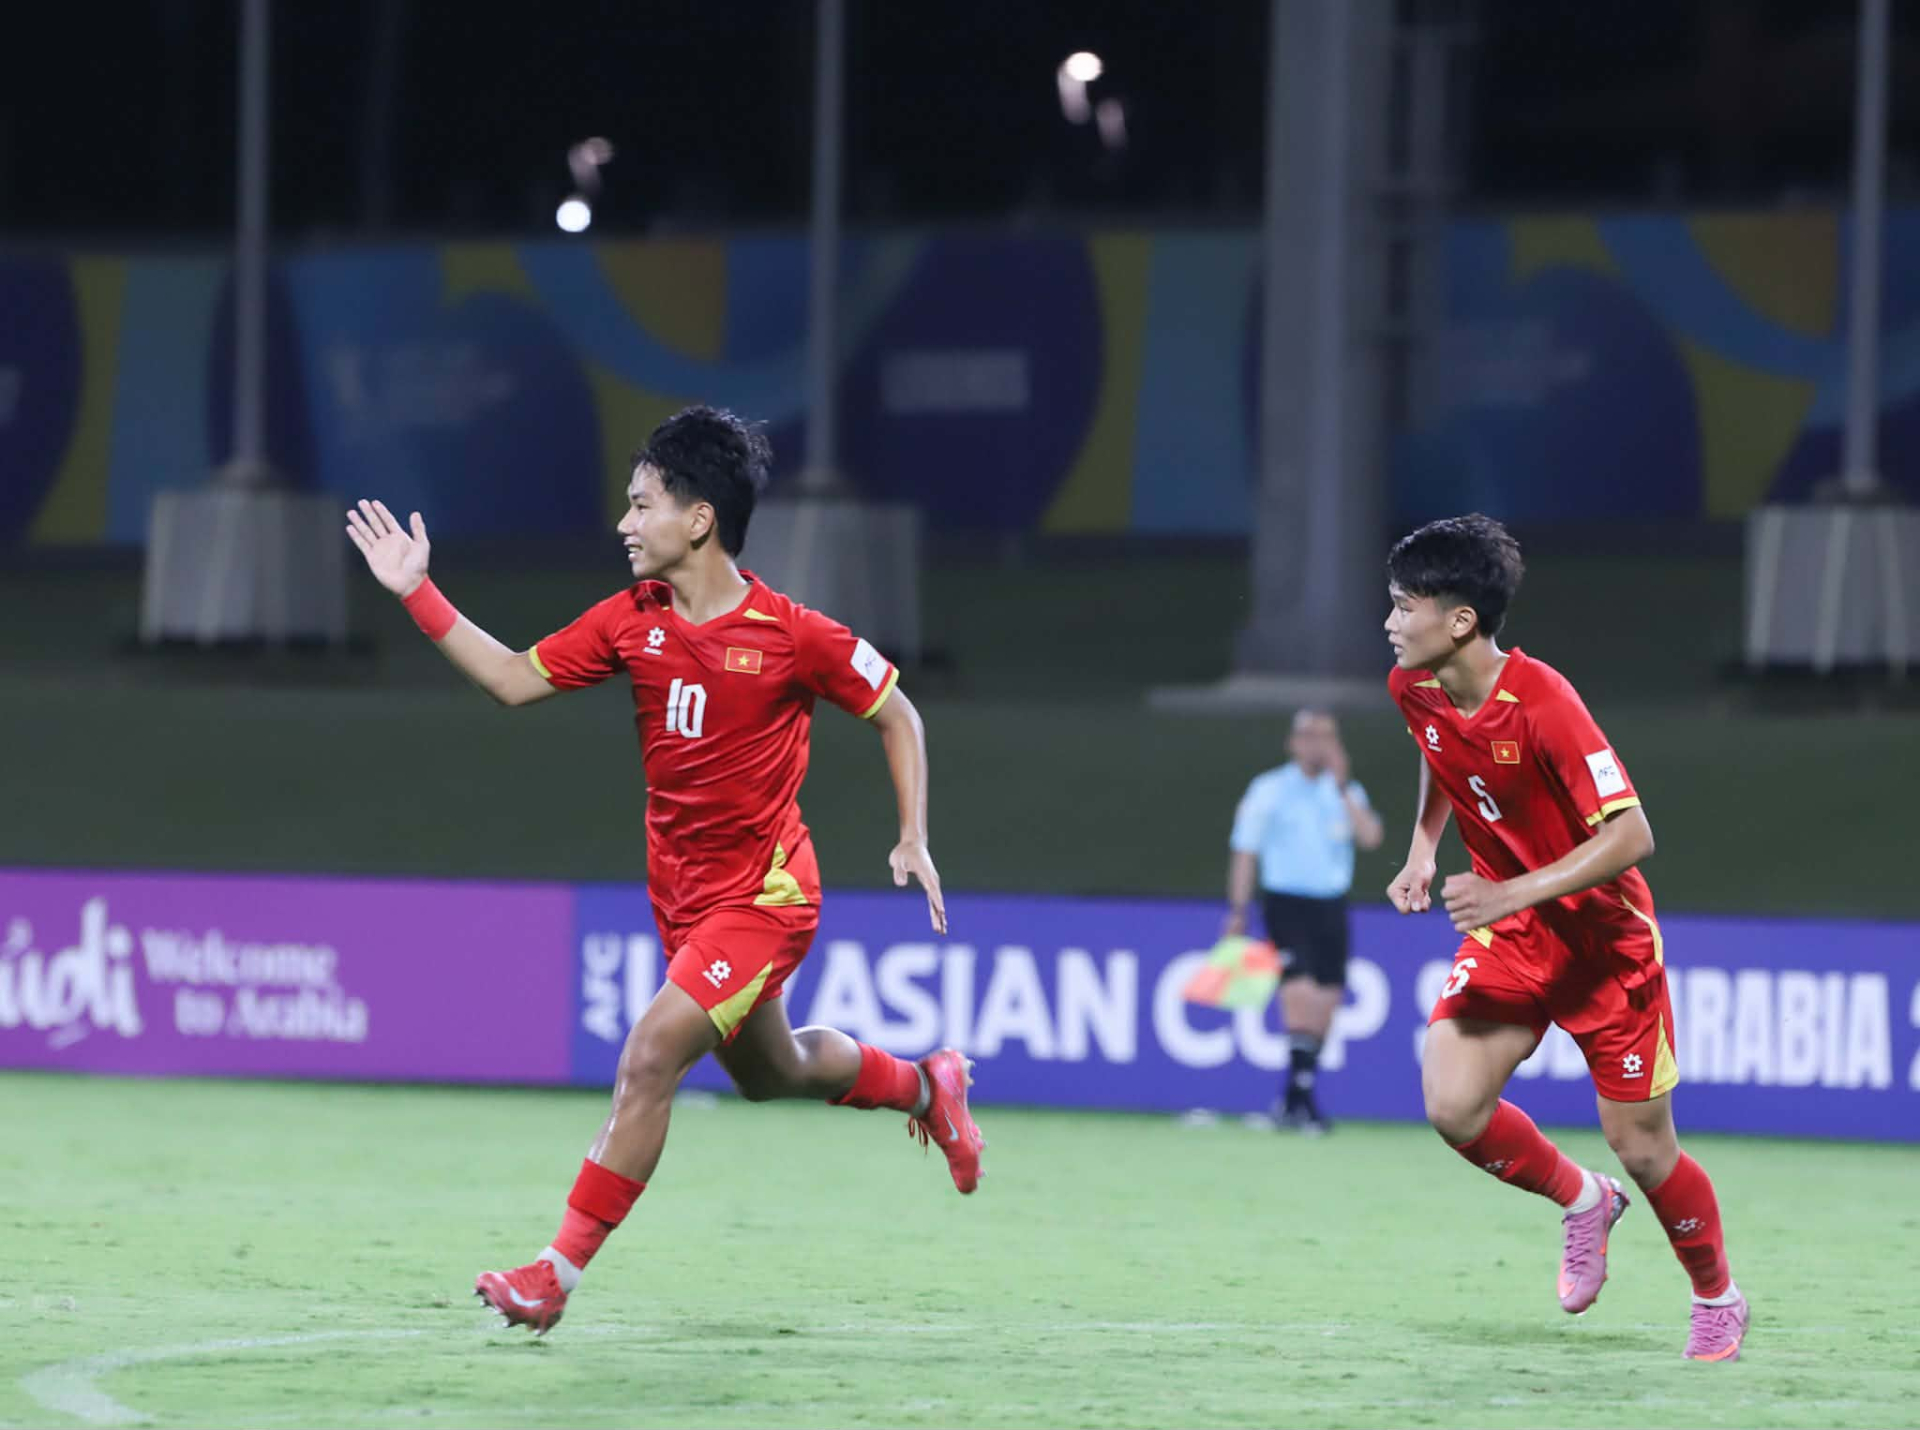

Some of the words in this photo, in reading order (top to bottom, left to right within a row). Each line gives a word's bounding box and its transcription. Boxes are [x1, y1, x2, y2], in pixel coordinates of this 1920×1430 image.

[665, 677, 708, 739] 10
[1467, 774, 1502, 823] 5
[141, 928, 339, 987] Welcome
[1441, 957, 1478, 1000] 5
[173, 986, 226, 1037] to
[582, 932, 623, 1043] AFC
[803, 940, 1138, 1063] ASIAN
